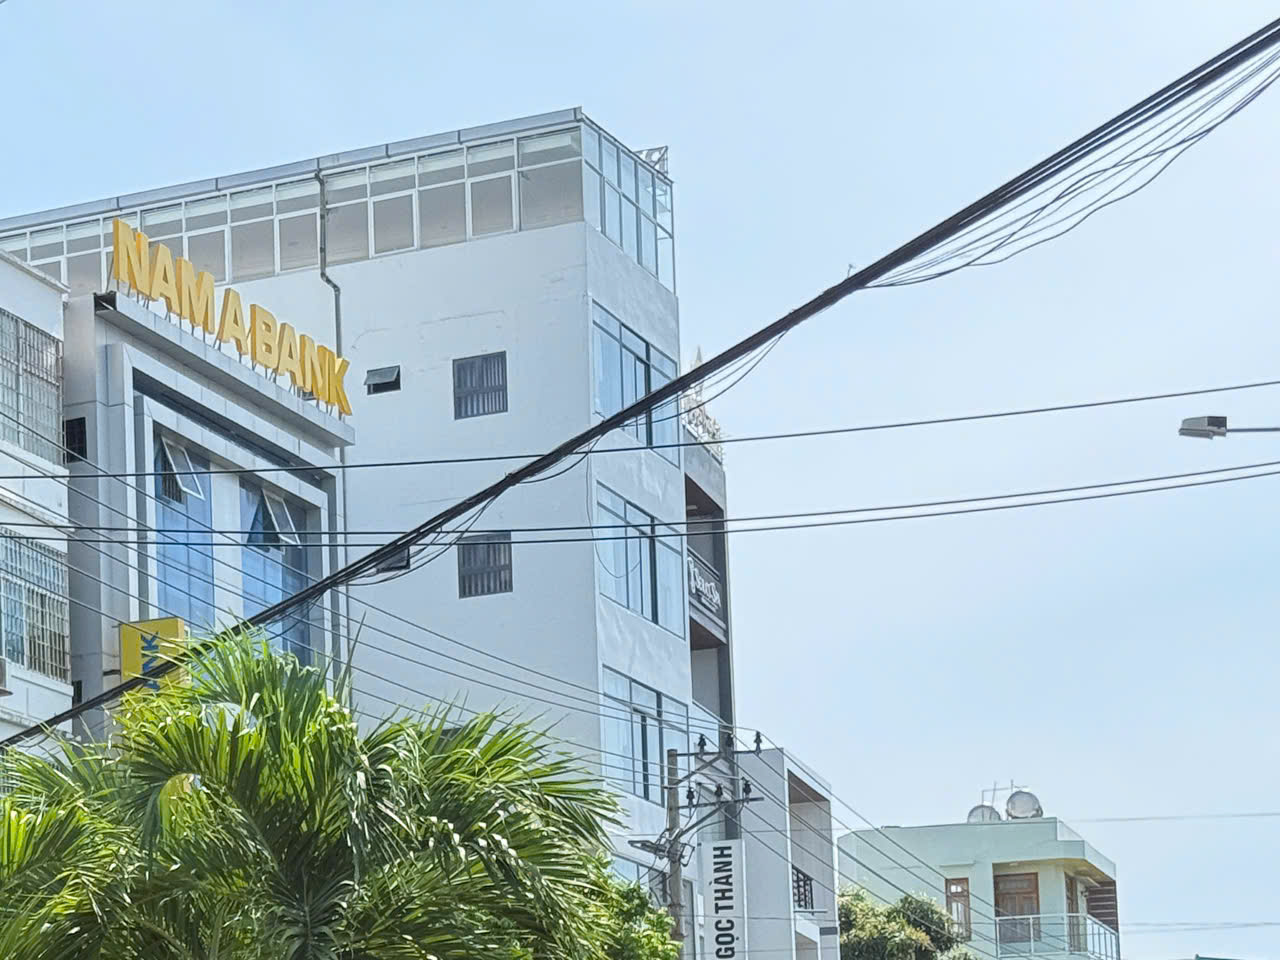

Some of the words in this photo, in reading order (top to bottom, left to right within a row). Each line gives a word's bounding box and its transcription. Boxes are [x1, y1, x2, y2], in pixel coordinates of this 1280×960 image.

[113, 216, 215, 335] NAM
[249, 303, 353, 416] BANK
[709, 846, 734, 914] THÀNH
